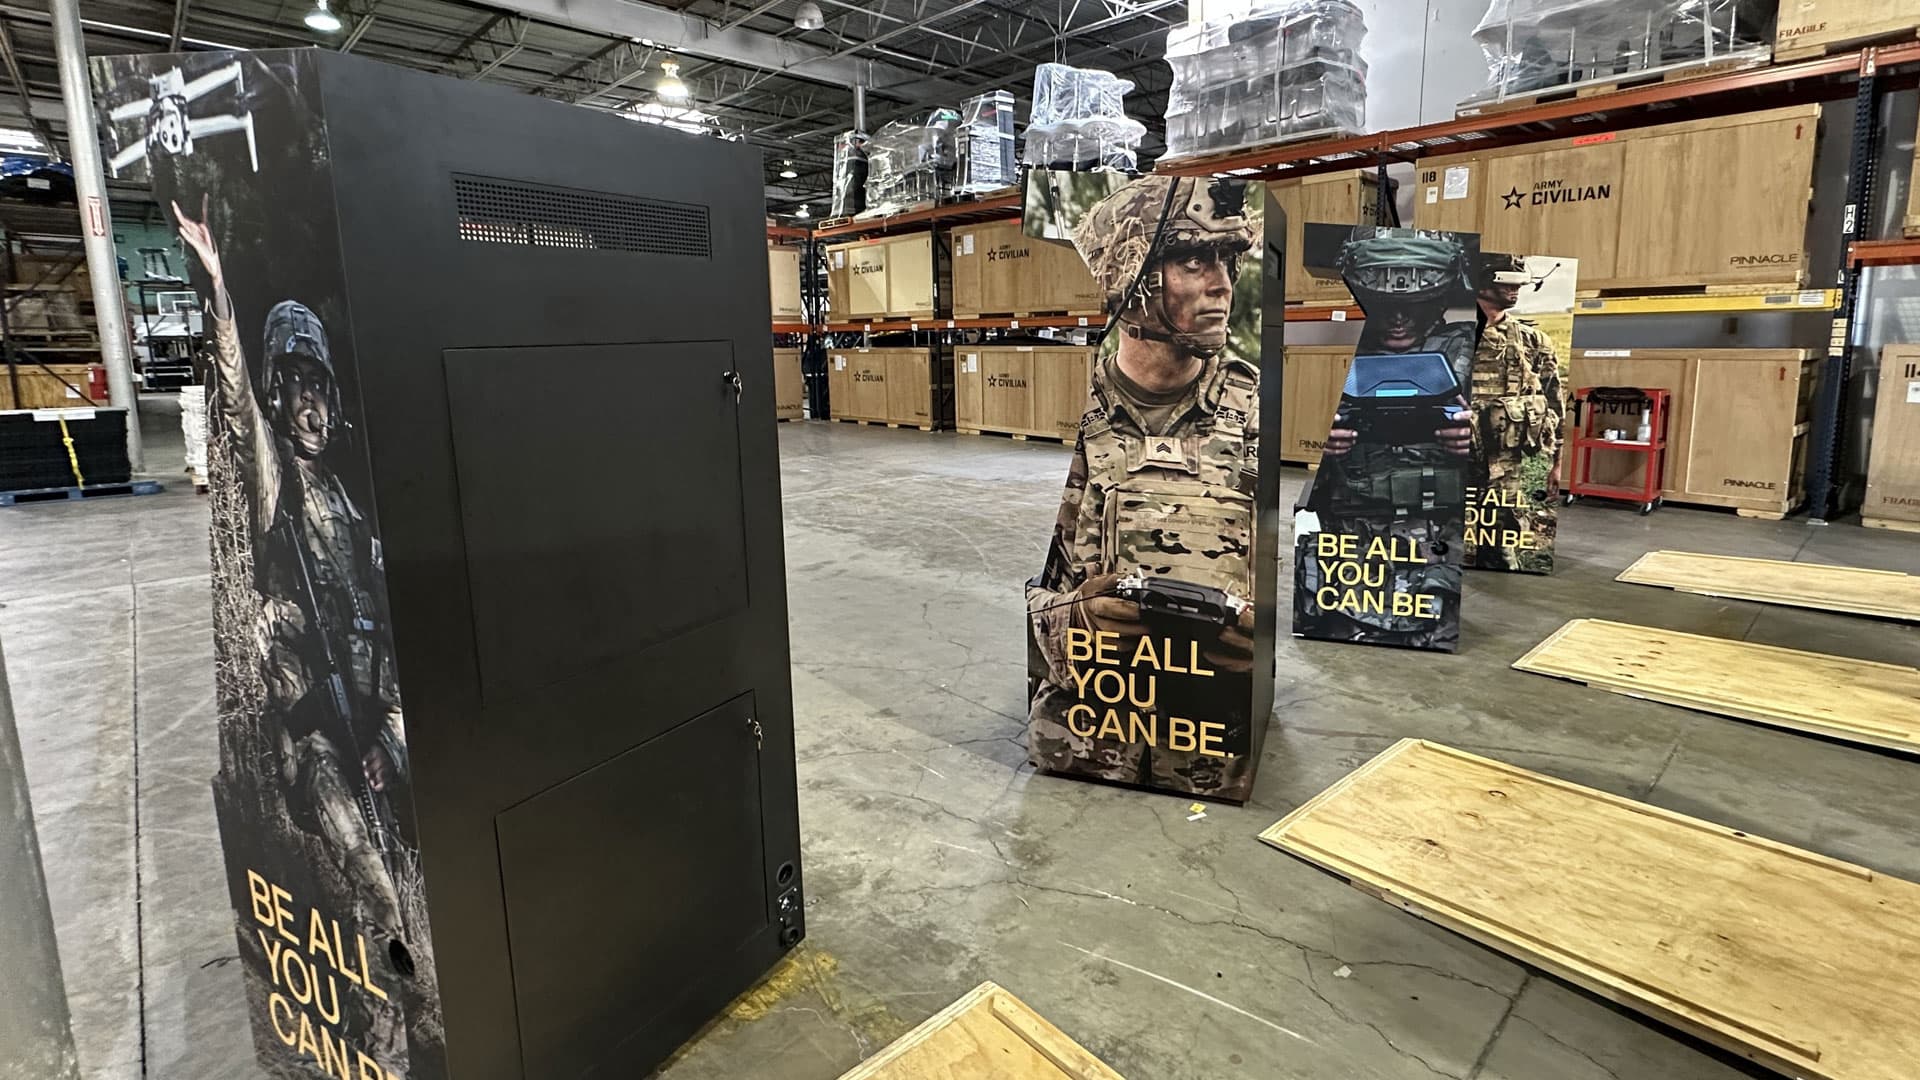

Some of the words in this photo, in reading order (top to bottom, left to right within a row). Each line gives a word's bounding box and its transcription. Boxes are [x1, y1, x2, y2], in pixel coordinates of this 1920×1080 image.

[1778, 22, 1827, 38] FRAGILE
[1422, 171, 1437, 183] 118
[1533, 179, 1564, 191] ARMY
[1531, 184, 1611, 206] CIVILIAN
[998, 248, 1030, 260] CIVILIAN
[1730, 253, 1799, 265] PINNACLE
[1723, 478, 1776, 490] PINNACLE
[1482, 488, 1531, 508] ALL
[1318, 533, 1360, 559] BE
[1365, 536, 1428, 563] ALL
[1501, 529, 1540, 550] BE.
[1318, 559, 1385, 587] YOU
[1316, 586, 1385, 615] CAN
[1392, 591, 1441, 619] BE.
[1067, 627, 1121, 665] BE
[1130, 635, 1215, 677] ALL
[1069, 665, 1156, 708] YOU
[1067, 704, 1157, 747] CAN
[1169, 717, 1235, 758] BE.
[247, 868, 300, 946] BE
[309, 907, 389, 1001] ALL
[257, 928, 340, 1025] YOU
[268, 992, 351, 1080] CAN
